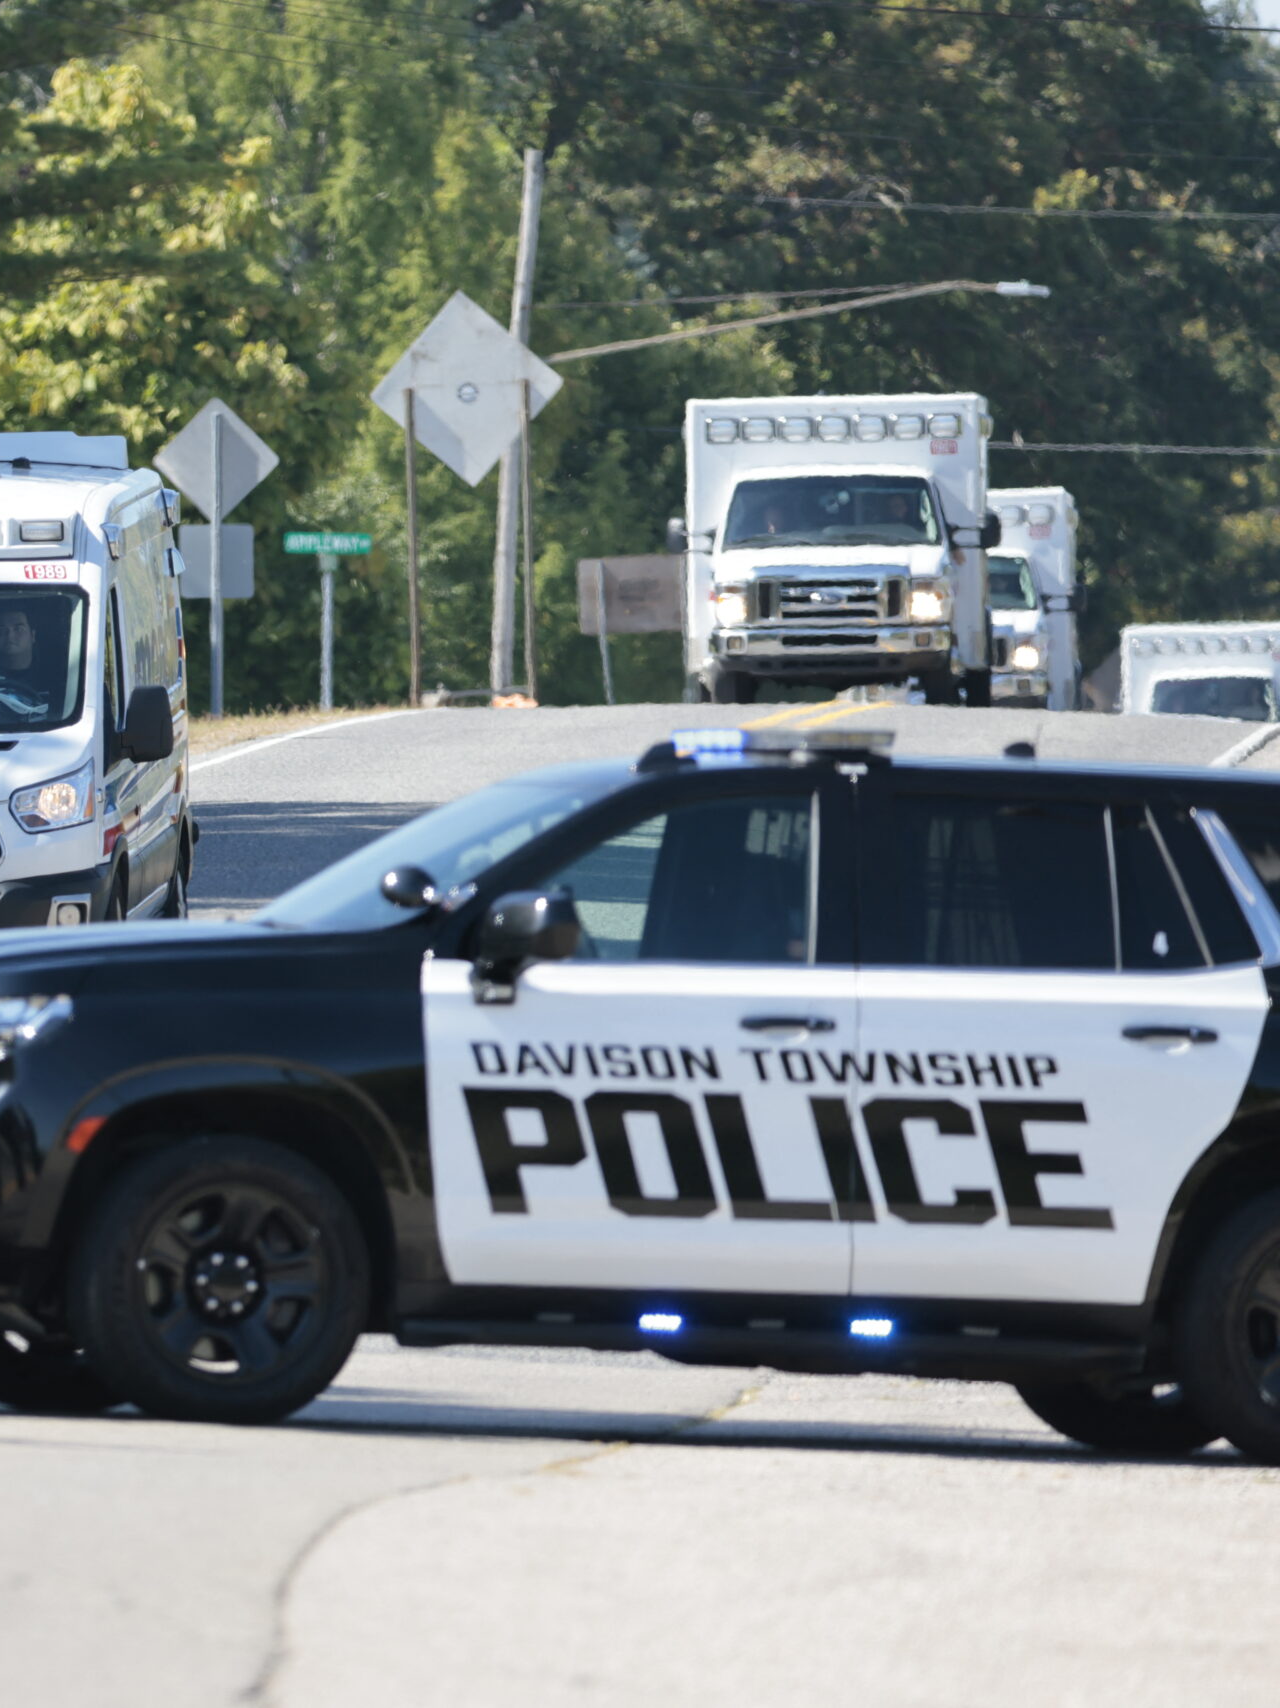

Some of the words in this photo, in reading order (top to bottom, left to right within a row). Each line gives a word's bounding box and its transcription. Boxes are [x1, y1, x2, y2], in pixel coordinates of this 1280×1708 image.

[24, 564, 66, 579] 1989
[469, 1040, 720, 1080] DAVISON
[739, 1047, 1059, 1088] TOWNSHIP
[461, 1085, 1116, 1230] POLICE
